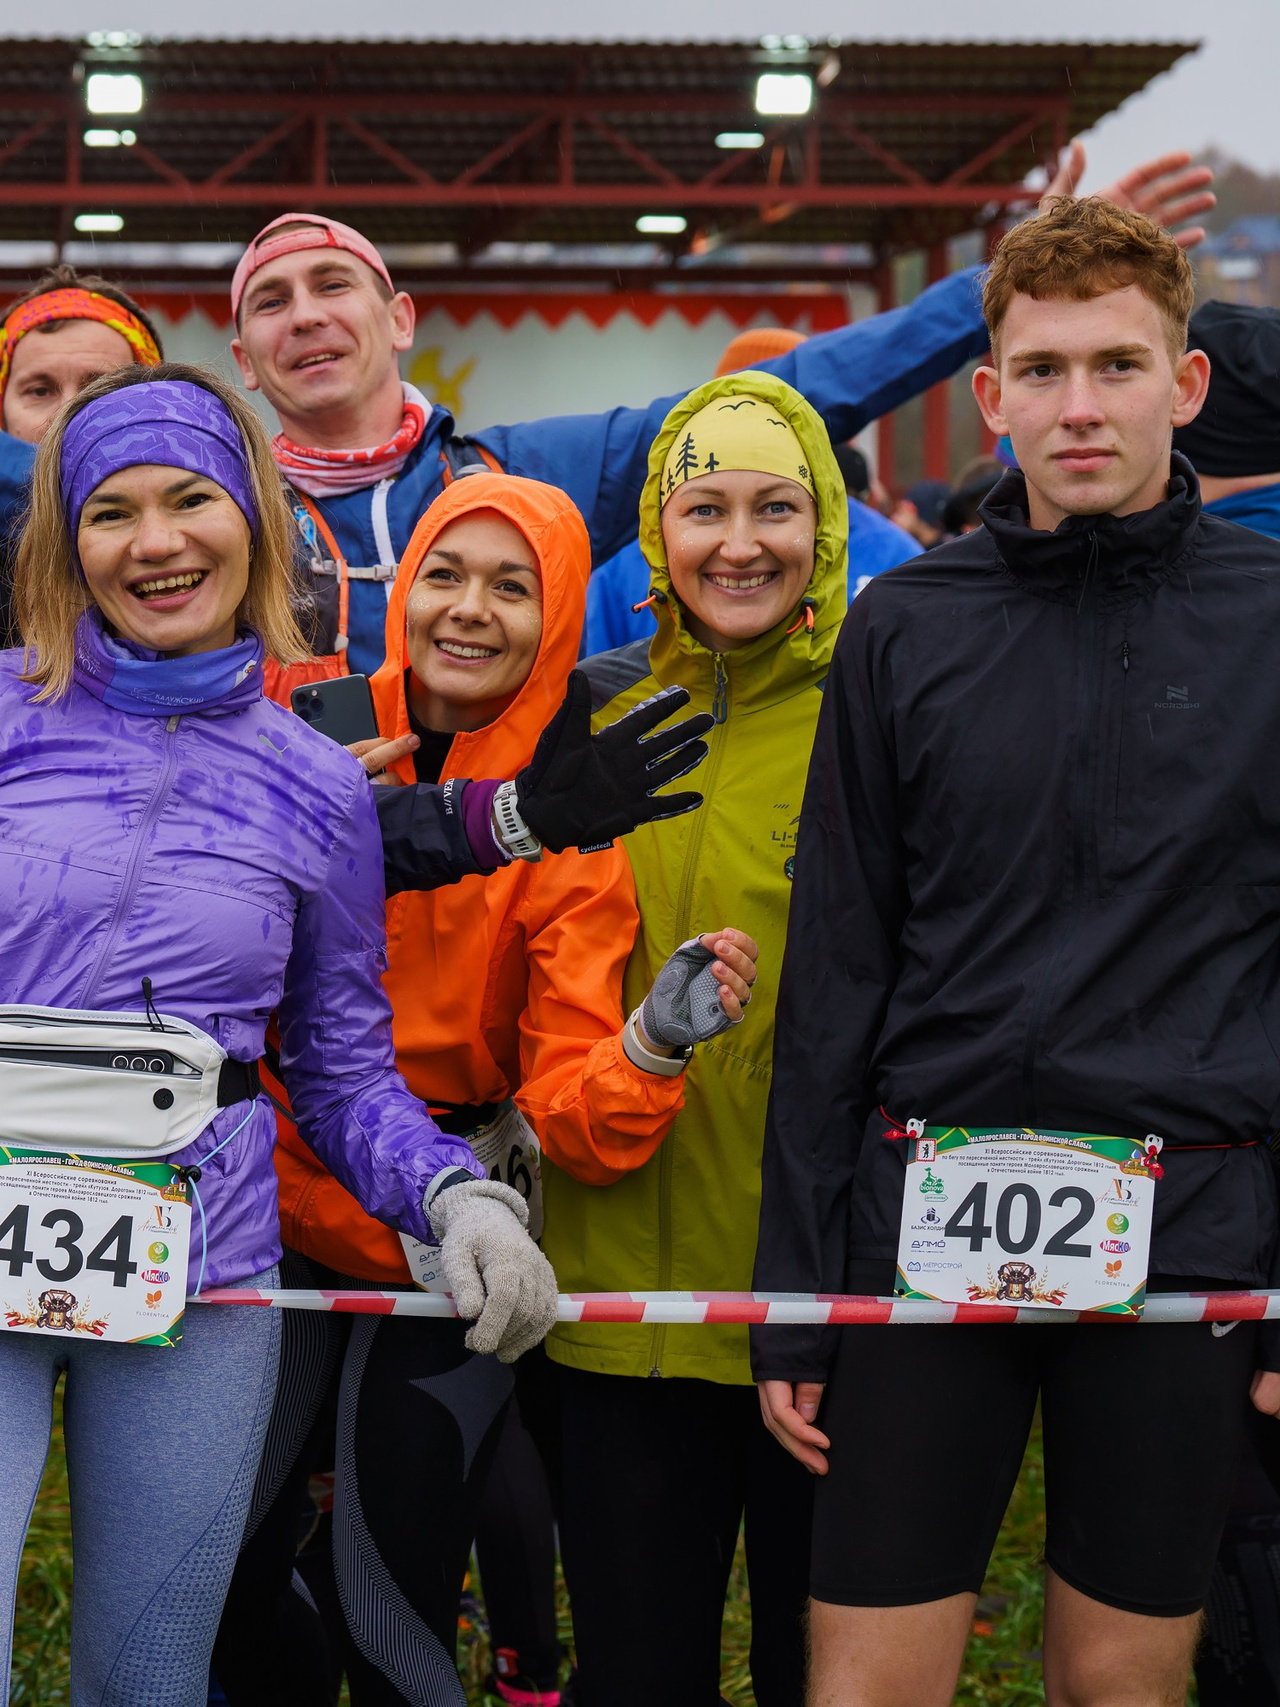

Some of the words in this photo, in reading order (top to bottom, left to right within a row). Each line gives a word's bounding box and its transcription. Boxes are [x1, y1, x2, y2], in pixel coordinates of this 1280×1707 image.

[580, 841, 611, 854] cyclotech
[1020, 1133, 1039, 1141] ГОРОД
[991, 1148, 1032, 1156] Всероссийские
[1033, 1150, 1073, 1158] соревнования
[8, 1156, 62, 1165] «МАЛОЯРОСЛАВЕЦ
[65, 1158, 84, 1167] ГОРОД
[83, 1160, 113, 1172] ВОИНСКОЙ
[112, 1165, 135, 1176] СЛАВЫ»
[33, 1170, 77, 1181] Всероссийские
[78, 1176, 117, 1185] соревнования
[6, 1176, 41, 1184] пересеченной
[111, 1186, 135, 1194] Дорогами
[33, 1190, 71, 1200] Отечественной
[68, 1188, 117, 1199] Малоярославецкого
[118, 1193, 142, 1201] сражения
[944, 1181, 1096, 1258] 402
[1094, 1279, 1131, 1288] FLORENTIKA
[135, 1310, 170, 1319] FLORENTIKA
